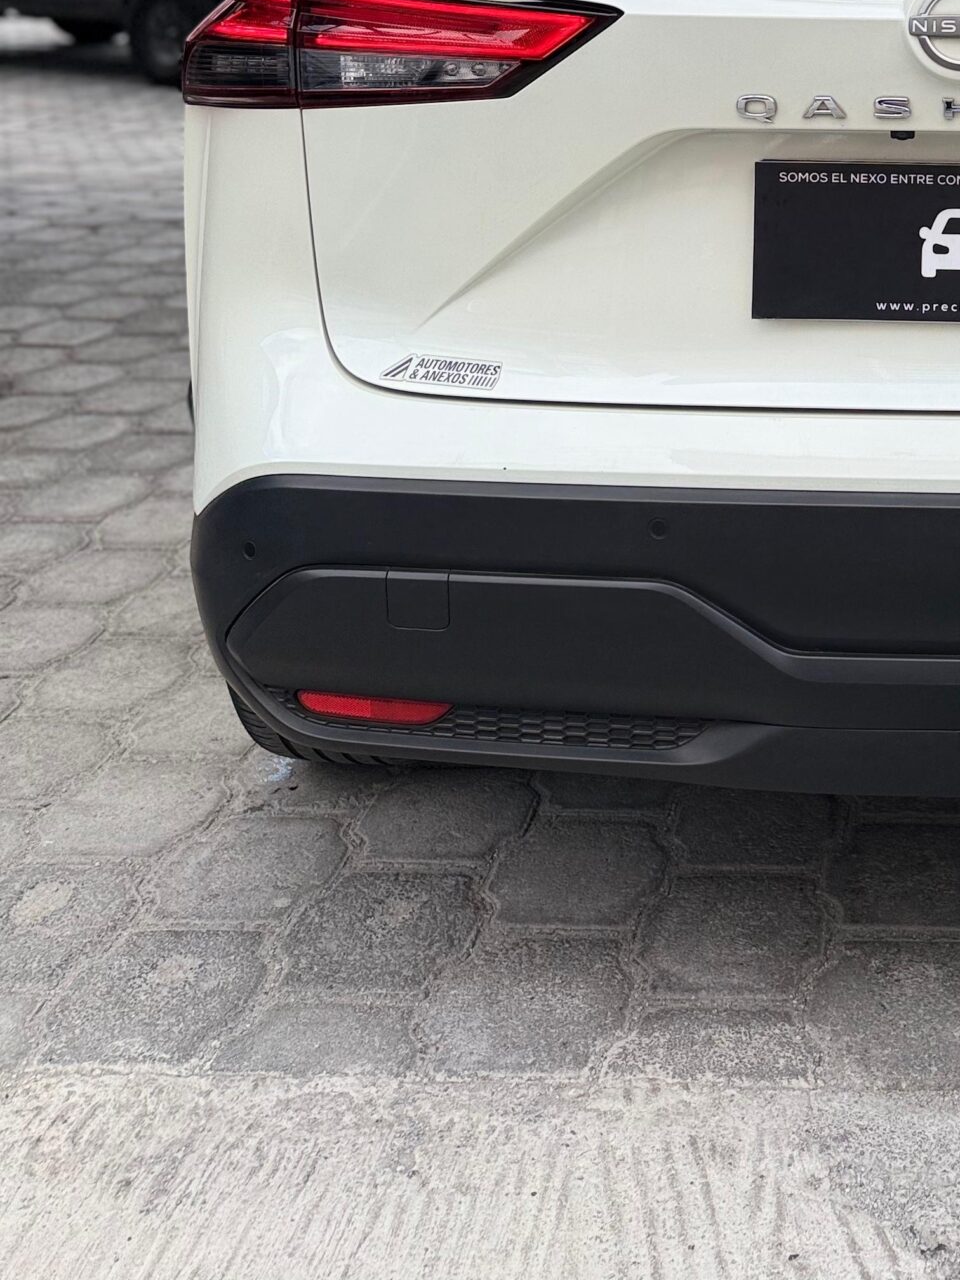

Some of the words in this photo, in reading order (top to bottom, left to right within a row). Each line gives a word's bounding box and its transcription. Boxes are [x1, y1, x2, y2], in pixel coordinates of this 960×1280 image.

[779, 171, 829, 183] SOMOS
[831, 172, 848, 183] EL
[850, 173, 887, 184] NEXO
[890, 173, 934, 185] ENTRE
[415, 357, 501, 376] AUTOMOTORES
[408, 368, 419, 380] &
[420, 370, 468, 385] ANEXOS
